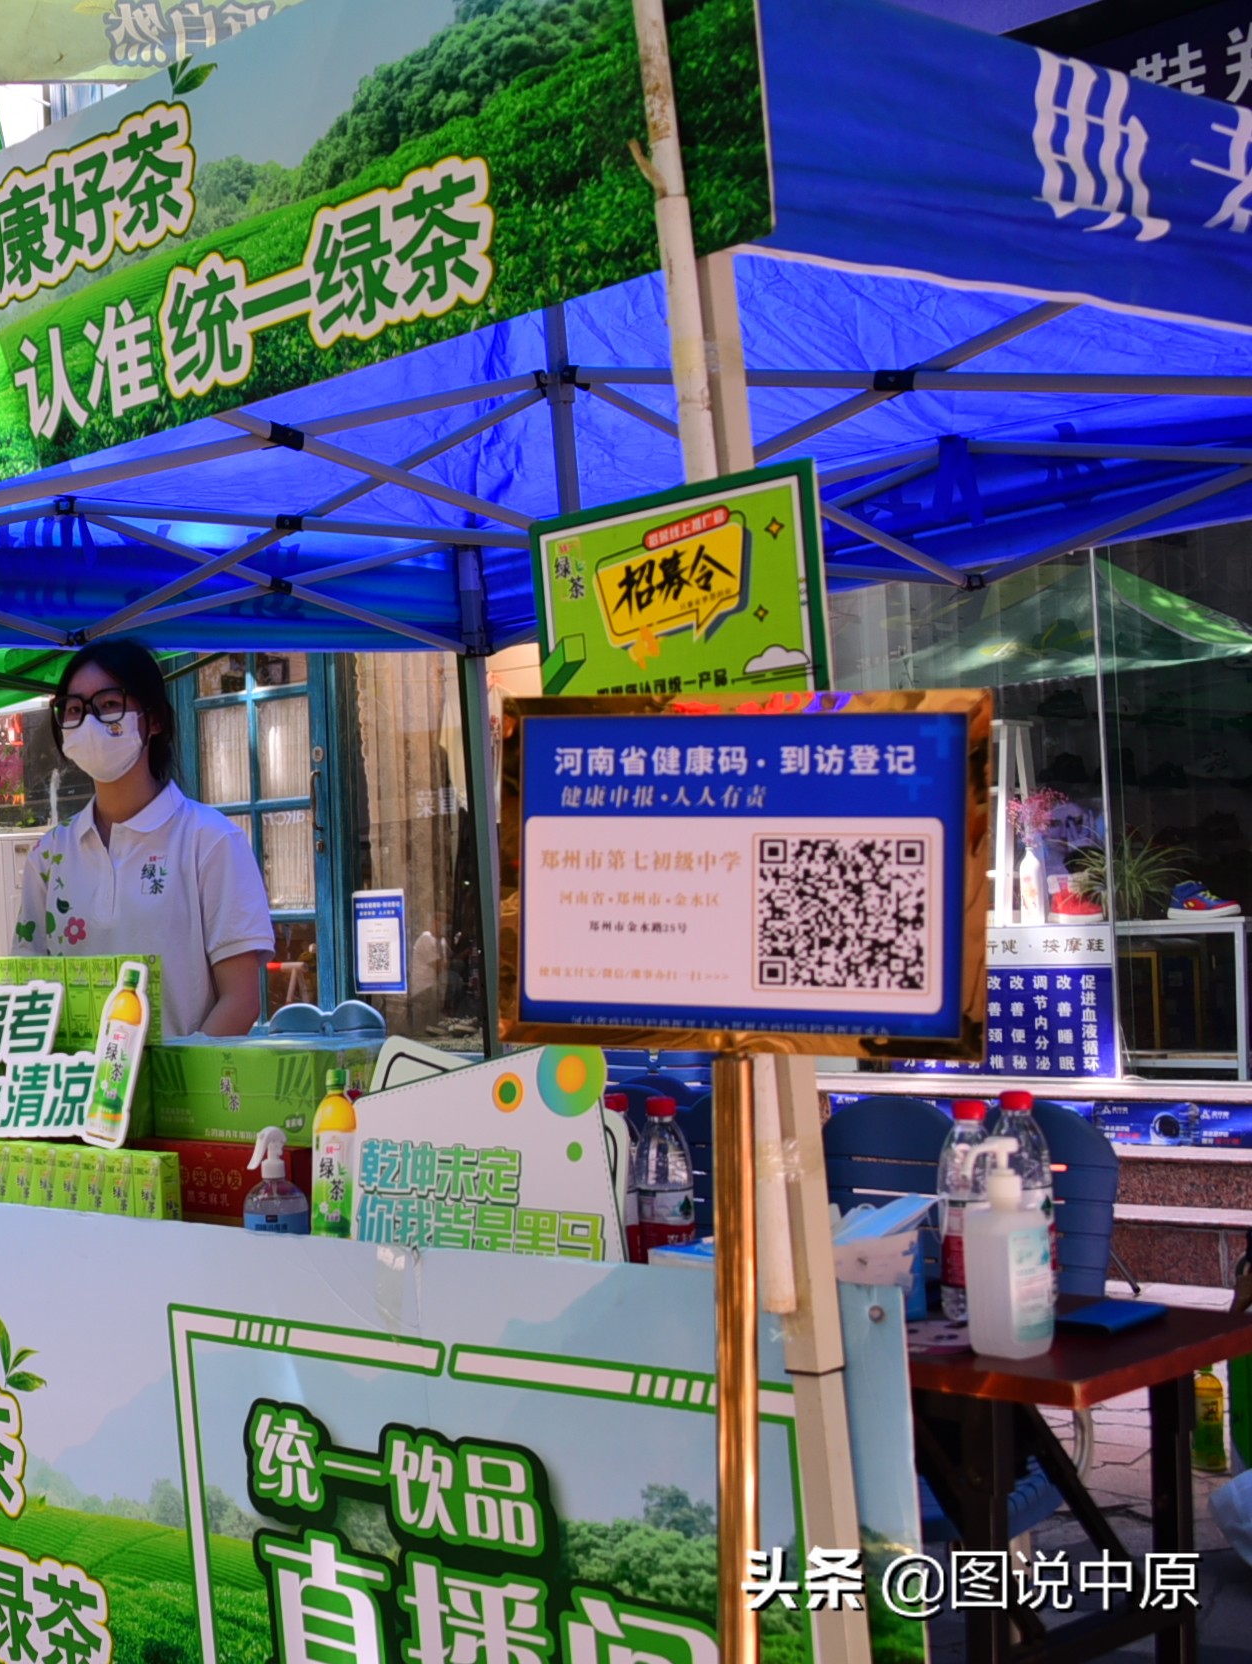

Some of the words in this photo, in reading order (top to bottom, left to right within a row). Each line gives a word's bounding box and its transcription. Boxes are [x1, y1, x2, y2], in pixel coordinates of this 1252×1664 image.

[15, 162, 488, 438] 认准统一绿茶
[554, 556, 585, 600] 绿茶
[613, 544, 736, 620] 招募令
[554, 745, 916, 777] 河南省健康码·到访登记
[560, 784, 768, 809] 健康申报·人人有责
[141, 864, 164, 895] 绿茶
[540, 848, 742, 873] 郑州市第七初级中学
[987, 975, 1004, 1070] 改善颈椎
[1010, 975, 1028, 1070] 改善便秘
[1033, 975, 1051, 1070] 调节内分泌
[1056, 975, 1075, 1071] 改善睡眠
[1080, 974, 1099, 1072] 促进血液循环
[105, 1041, 123, 1083] 绿茶
[220, 1077, 240, 1112] 绿茶
[319, 1157, 345, 1201] 绿茶
[360, 1140, 518, 1202] 乾坤未定
[357, 1195, 603, 1262] 你我皆是黑马
[255, 1411, 539, 1549] 统一饮品
